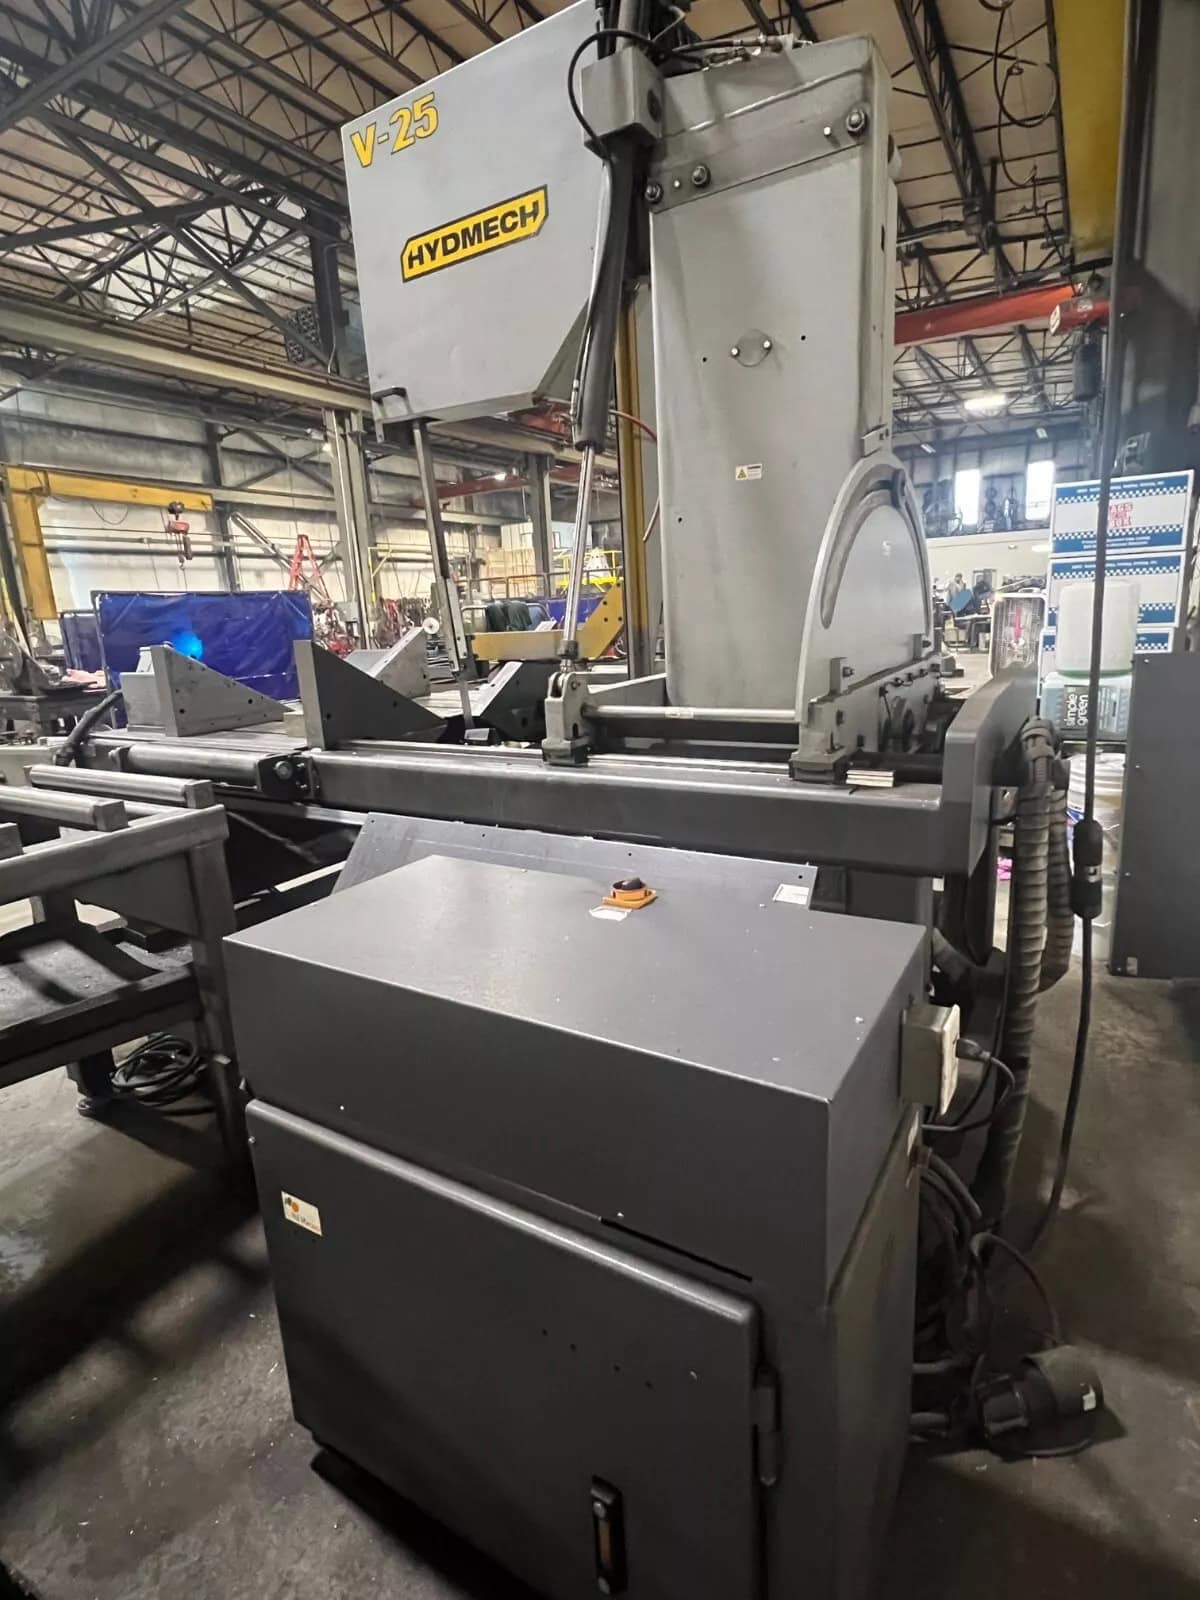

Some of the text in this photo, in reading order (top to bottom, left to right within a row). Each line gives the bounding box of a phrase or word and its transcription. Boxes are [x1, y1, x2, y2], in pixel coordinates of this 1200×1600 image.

[350, 91, 439, 168] V-25
[407, 199, 540, 270] HYDMECH
[1063, 693, 1078, 727] simple
[1077, 694, 1089, 727] green
